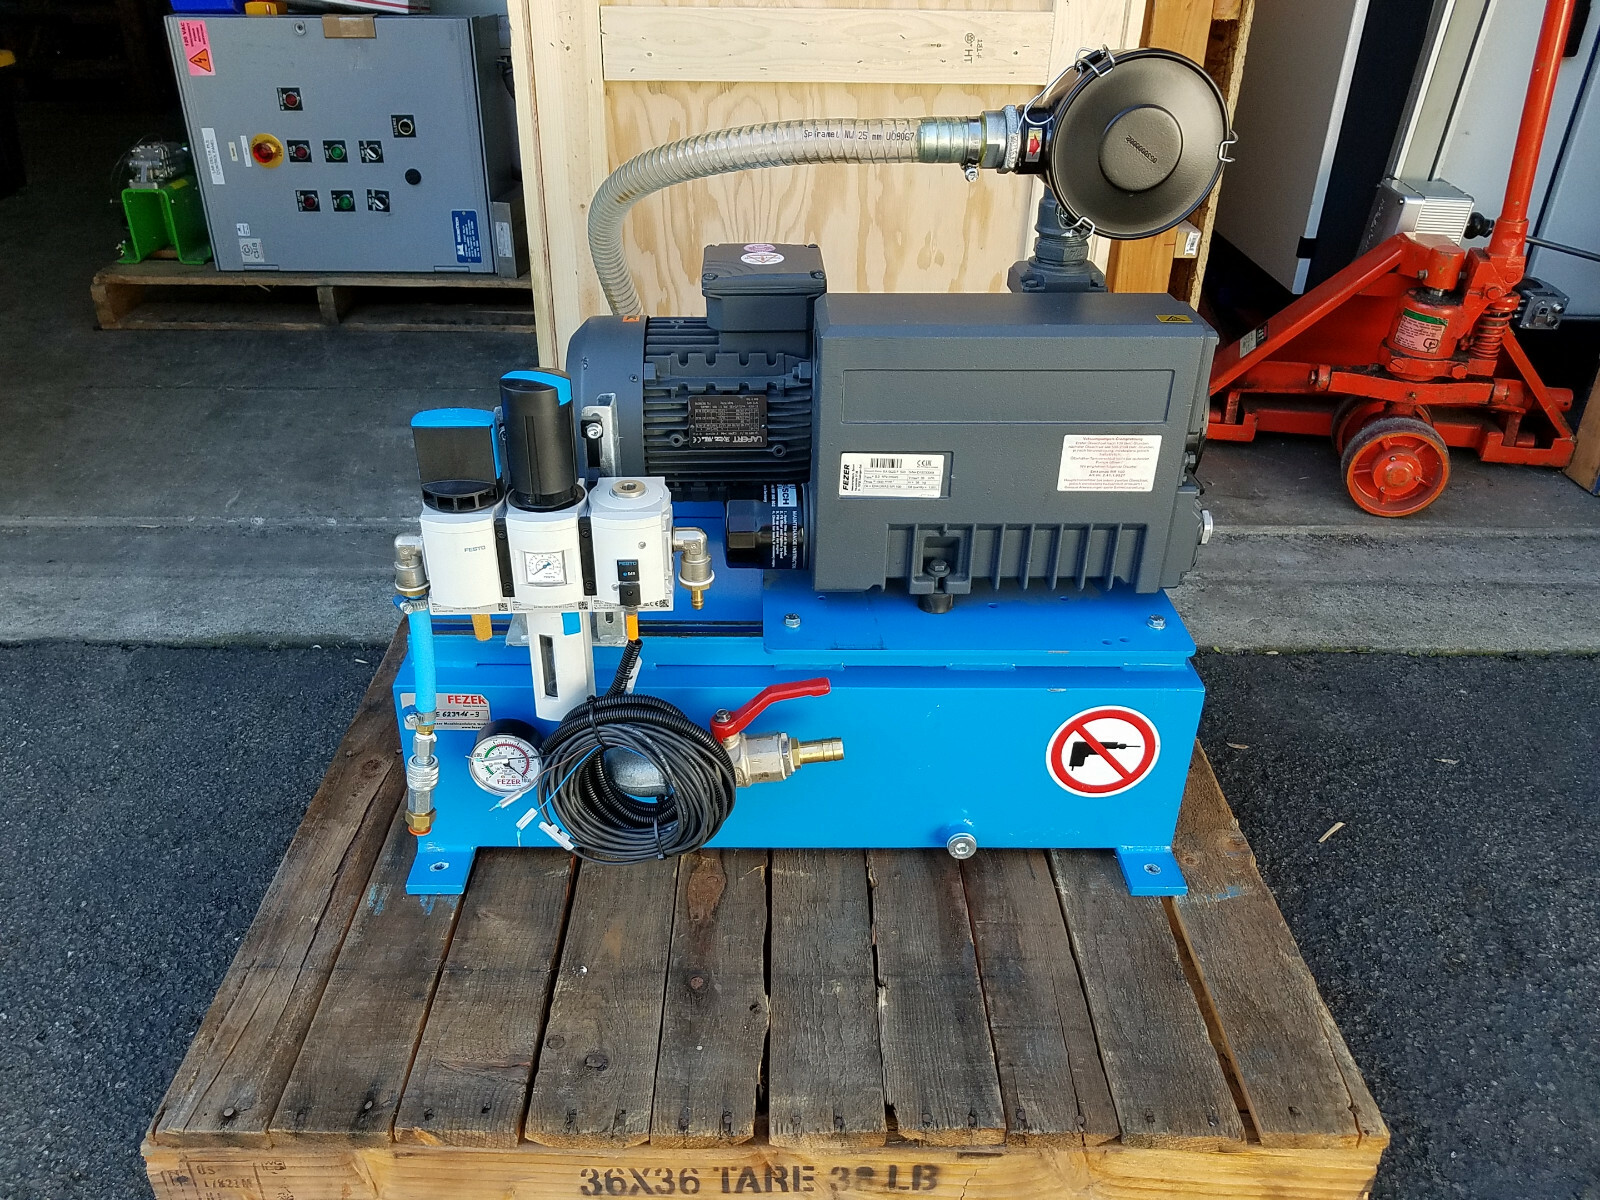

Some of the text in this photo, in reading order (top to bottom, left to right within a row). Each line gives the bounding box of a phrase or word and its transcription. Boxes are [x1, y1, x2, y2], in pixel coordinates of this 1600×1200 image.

[964, 49, 973, 63] HT
[858, 131, 868, 140] 25
[448, 695, 487, 704] FEZER
[580, 1168, 700, 1196] 36X36
[714, 1165, 814, 1193] TARE
[888, 1164, 939, 1191] LB
